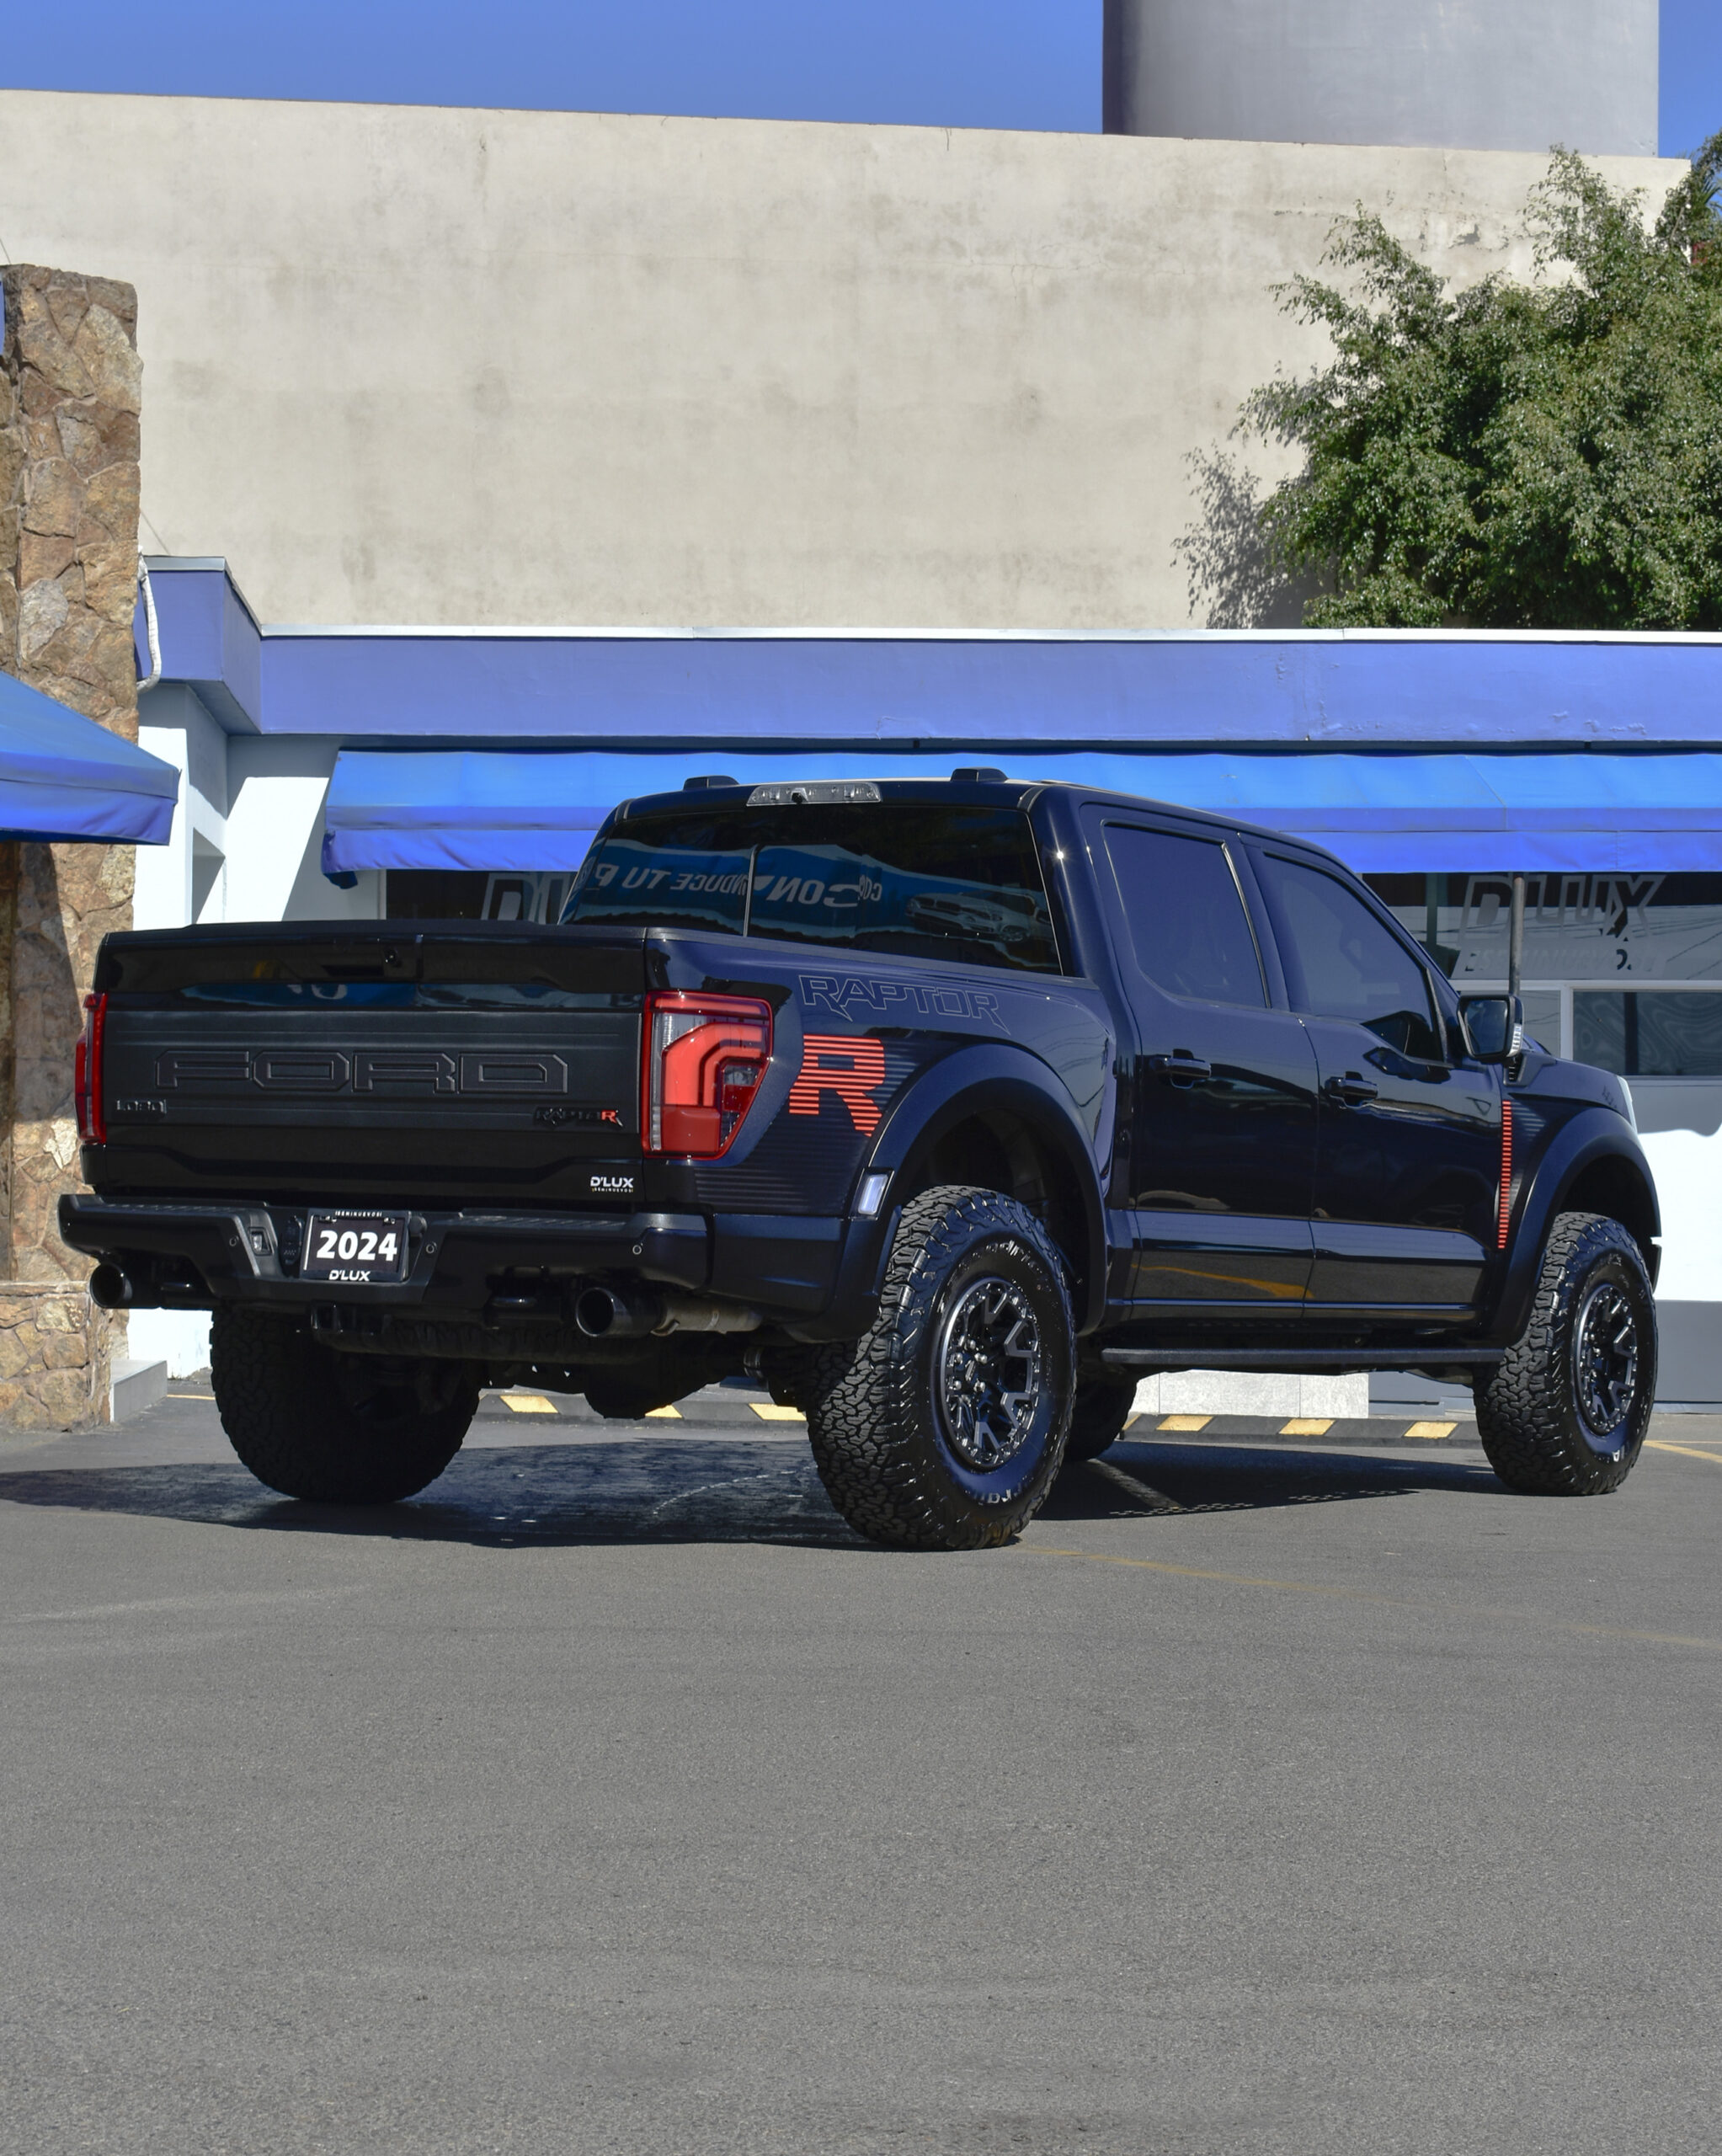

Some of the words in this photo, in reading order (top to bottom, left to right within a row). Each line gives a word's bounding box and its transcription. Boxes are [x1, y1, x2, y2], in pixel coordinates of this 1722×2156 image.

[799, 974, 1010, 1035] RAPTOR
[155, 1049, 568, 1094] FORD
[789, 1033, 886, 1137] R
[590, 1177, 634, 1188] D'LUX
[317, 1230, 397, 1262] 2024
[328, 1270, 371, 1282] D'LUX
